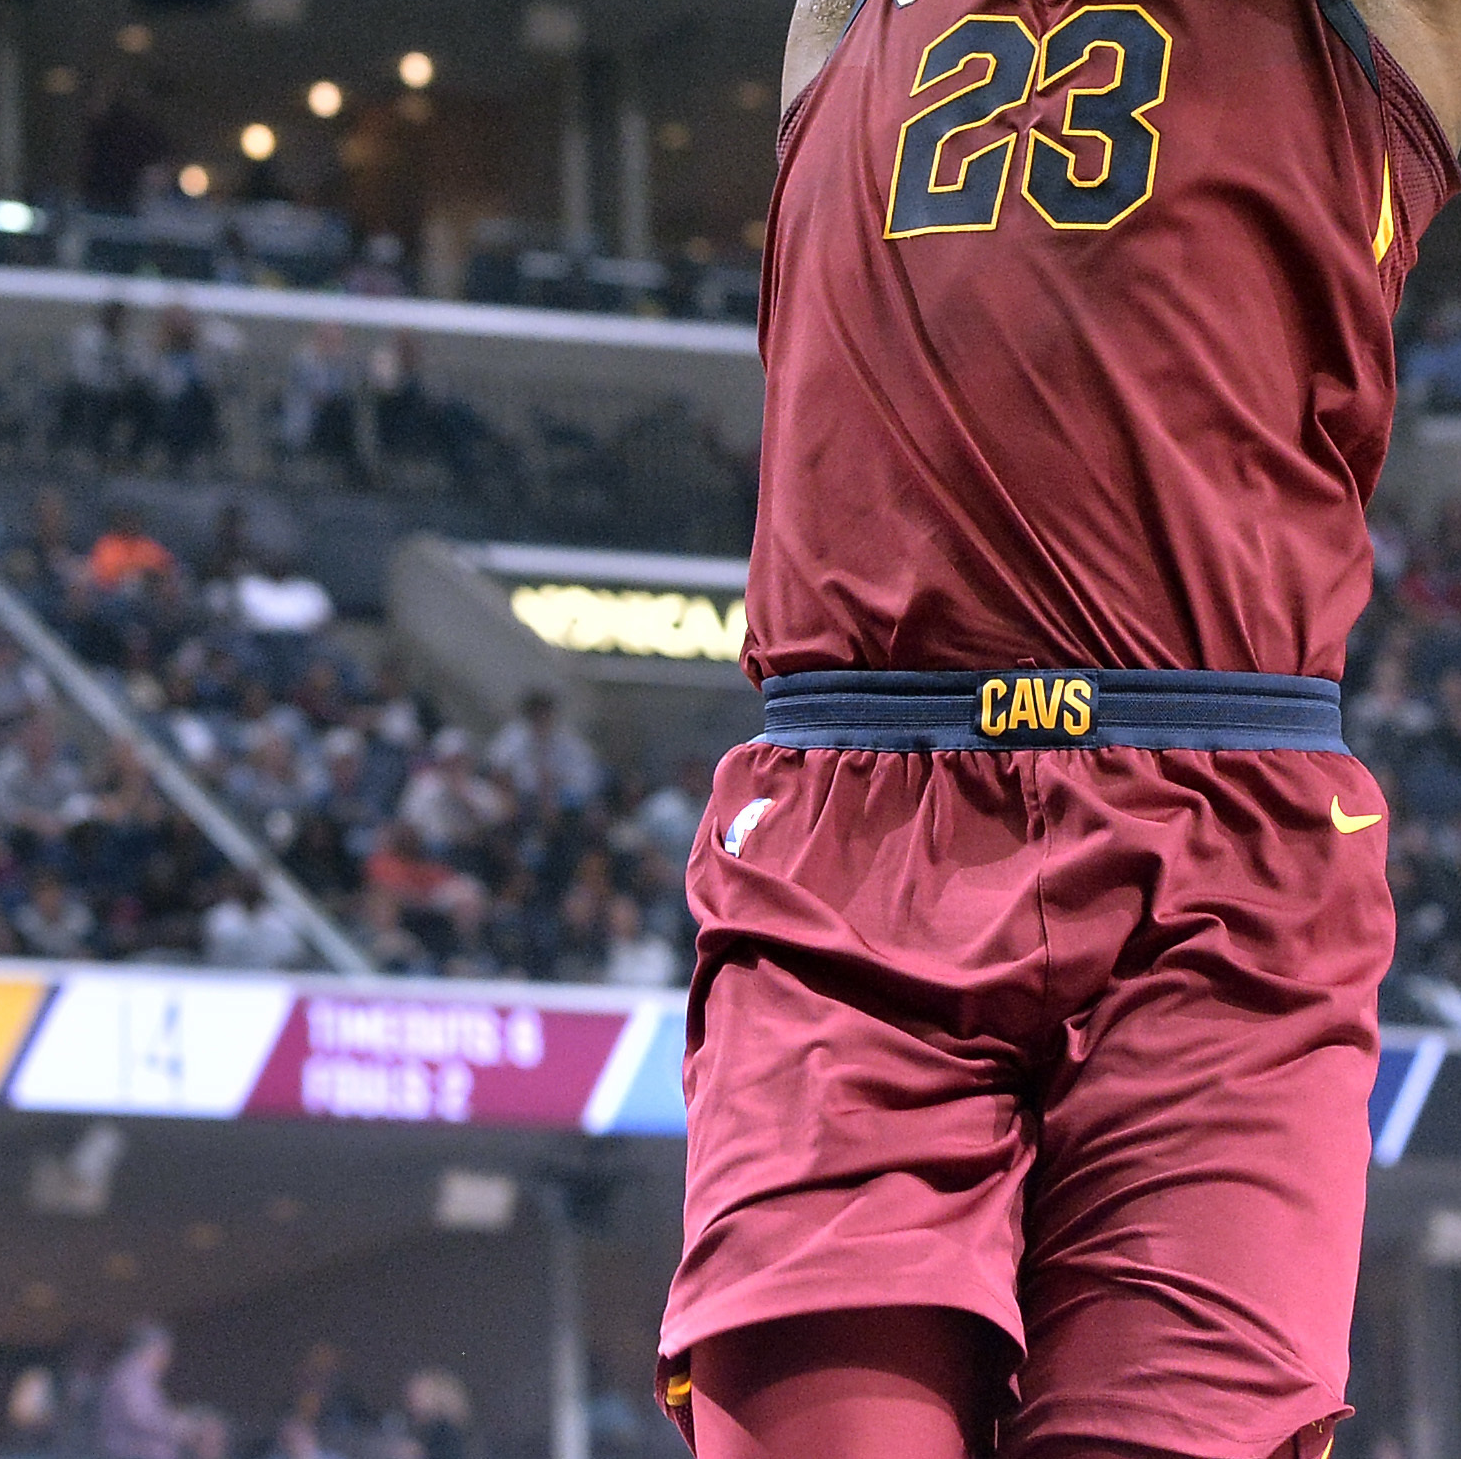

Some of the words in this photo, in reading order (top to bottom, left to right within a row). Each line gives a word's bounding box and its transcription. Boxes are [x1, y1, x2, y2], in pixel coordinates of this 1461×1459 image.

[882, 3, 1175, 240] 23
[978, 676, 1094, 738] CAVS
[305, 995, 502, 1067] TIMEOUTS
[300, 1052, 433, 1121] FOULS
